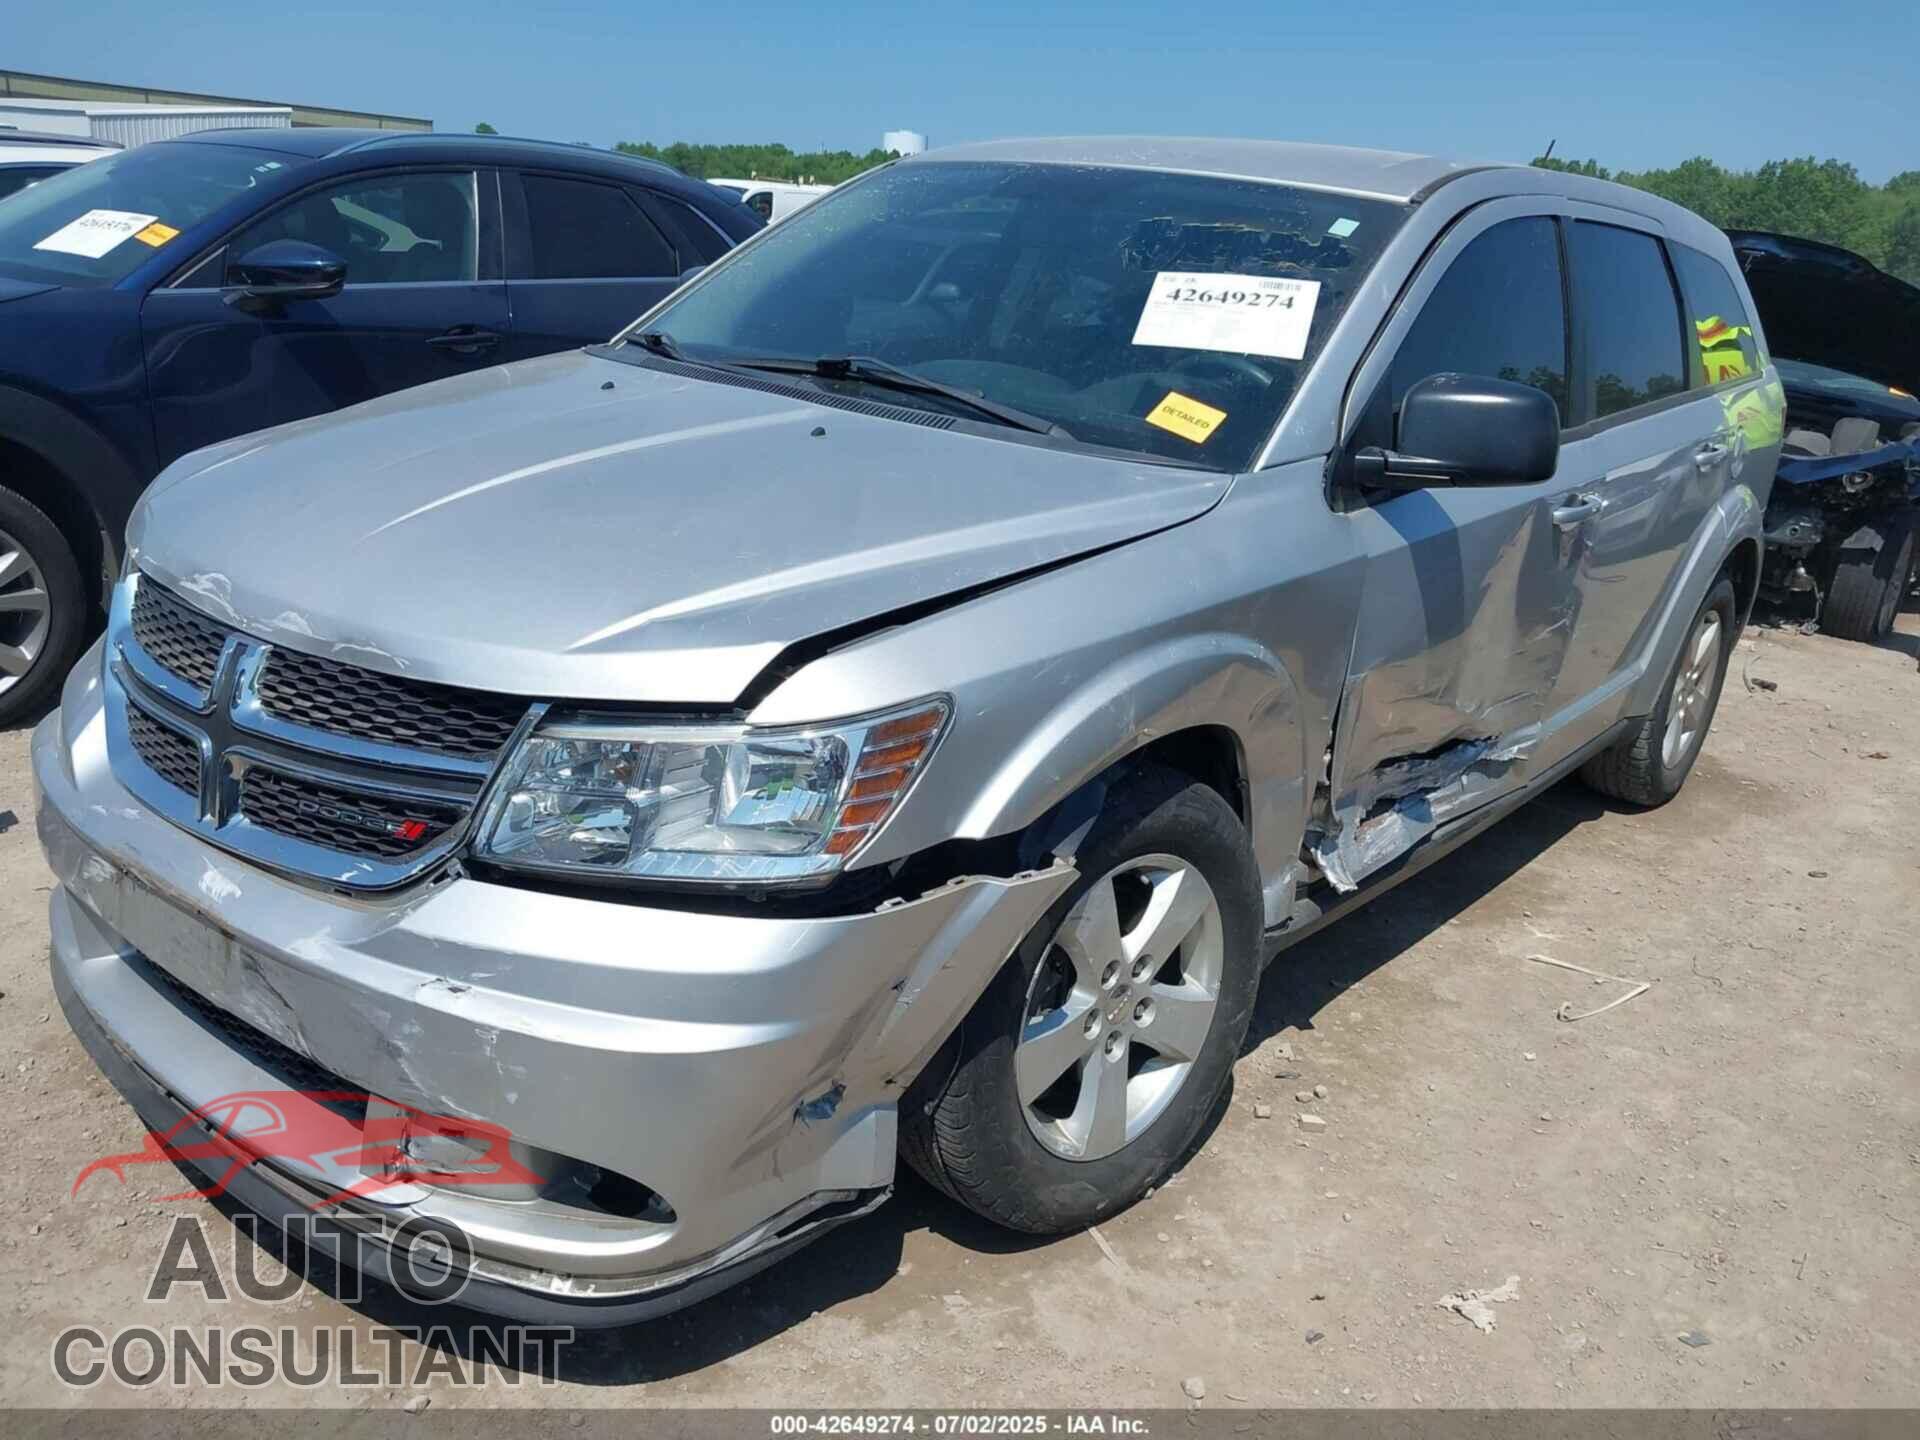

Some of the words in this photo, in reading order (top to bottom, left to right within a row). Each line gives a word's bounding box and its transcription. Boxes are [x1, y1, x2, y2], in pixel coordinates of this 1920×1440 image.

[1166, 287, 1294, 309] 42649274
[1161, 404, 1210, 430] DETAILED
[299, 800, 404, 833] DODGE
